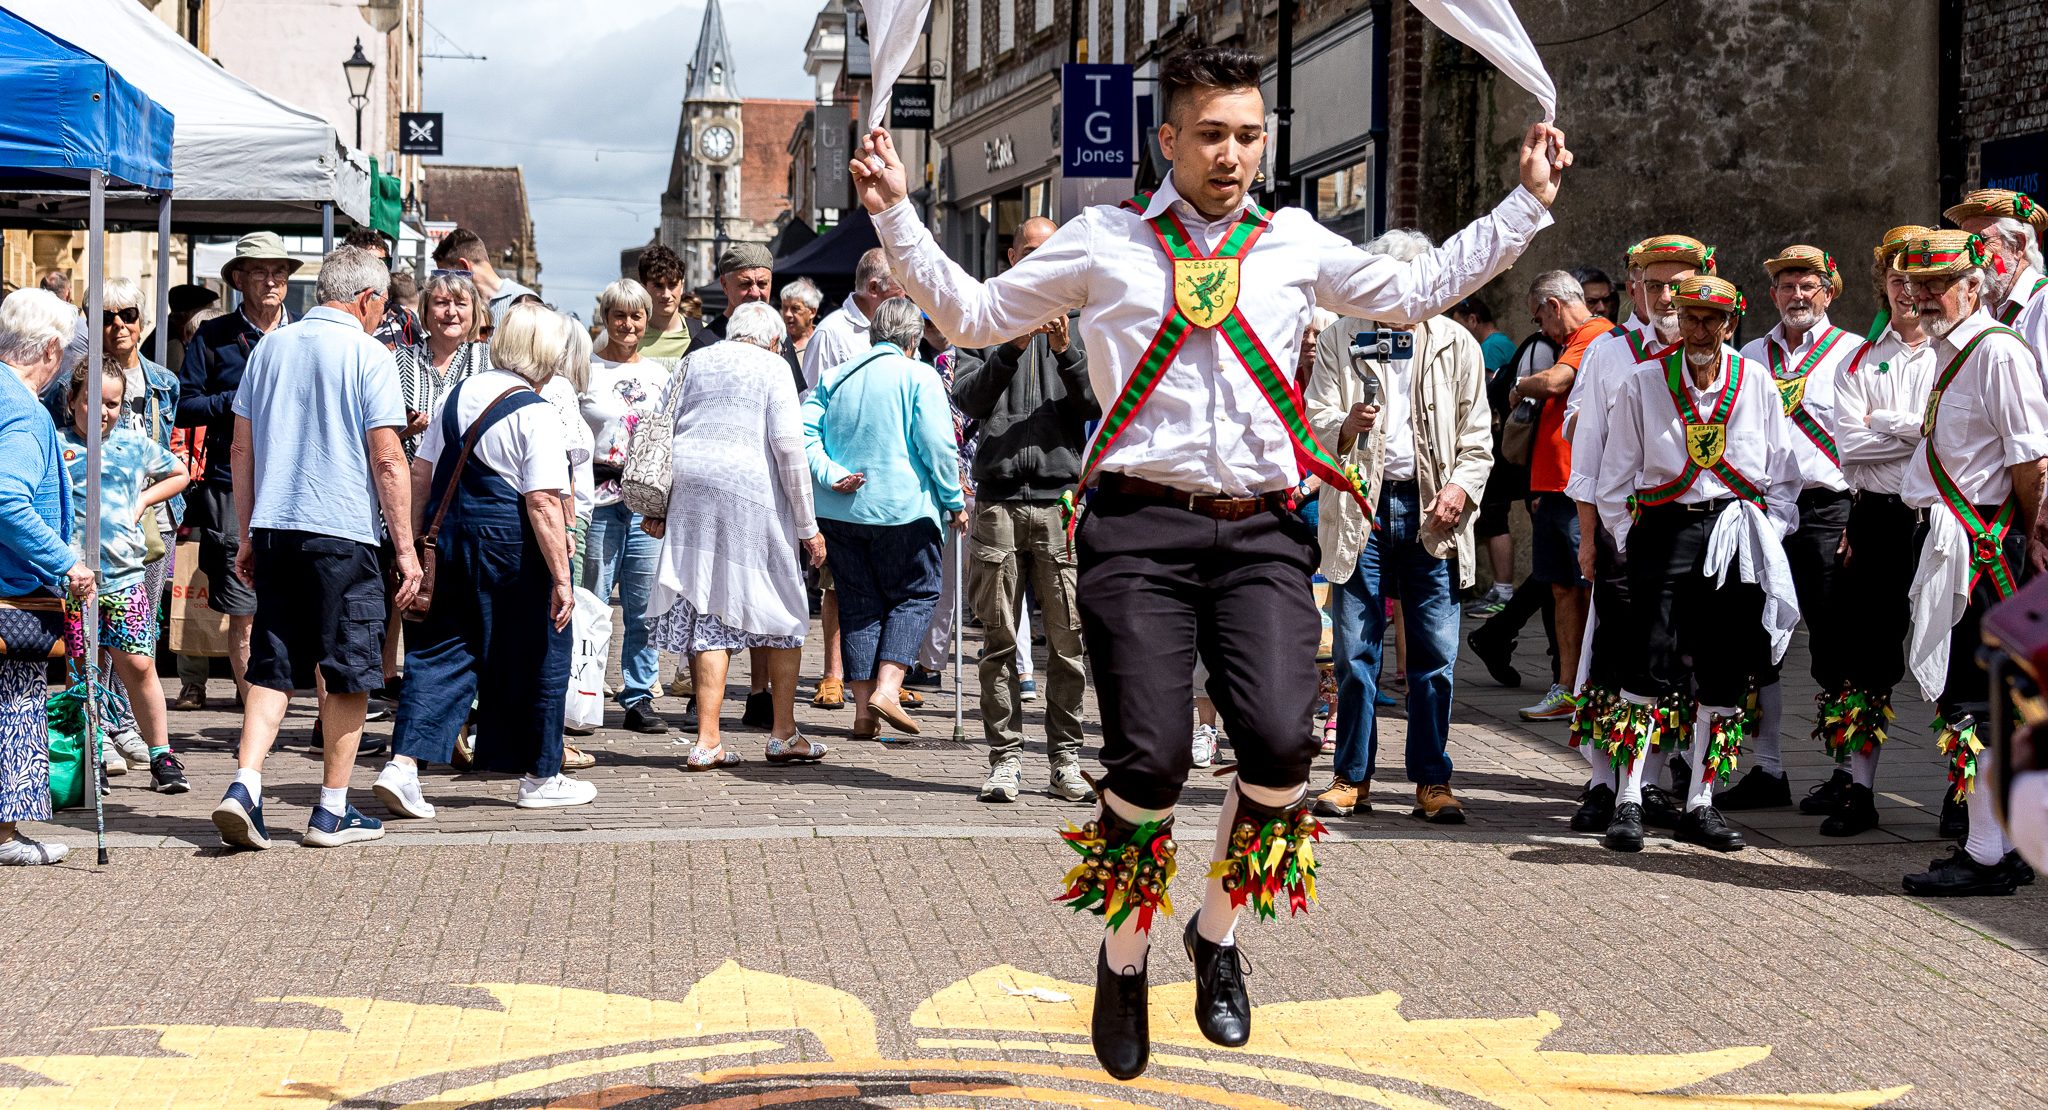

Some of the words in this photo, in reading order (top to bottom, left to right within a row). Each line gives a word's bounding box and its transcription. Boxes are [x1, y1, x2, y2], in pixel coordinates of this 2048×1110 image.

[1085, 74, 1112, 107] T
[899, 97, 926, 107] vision
[1085, 111, 1112, 144] G
[1072, 146, 1125, 167] Jones
[1184, 261, 1228, 270] WESSEX
